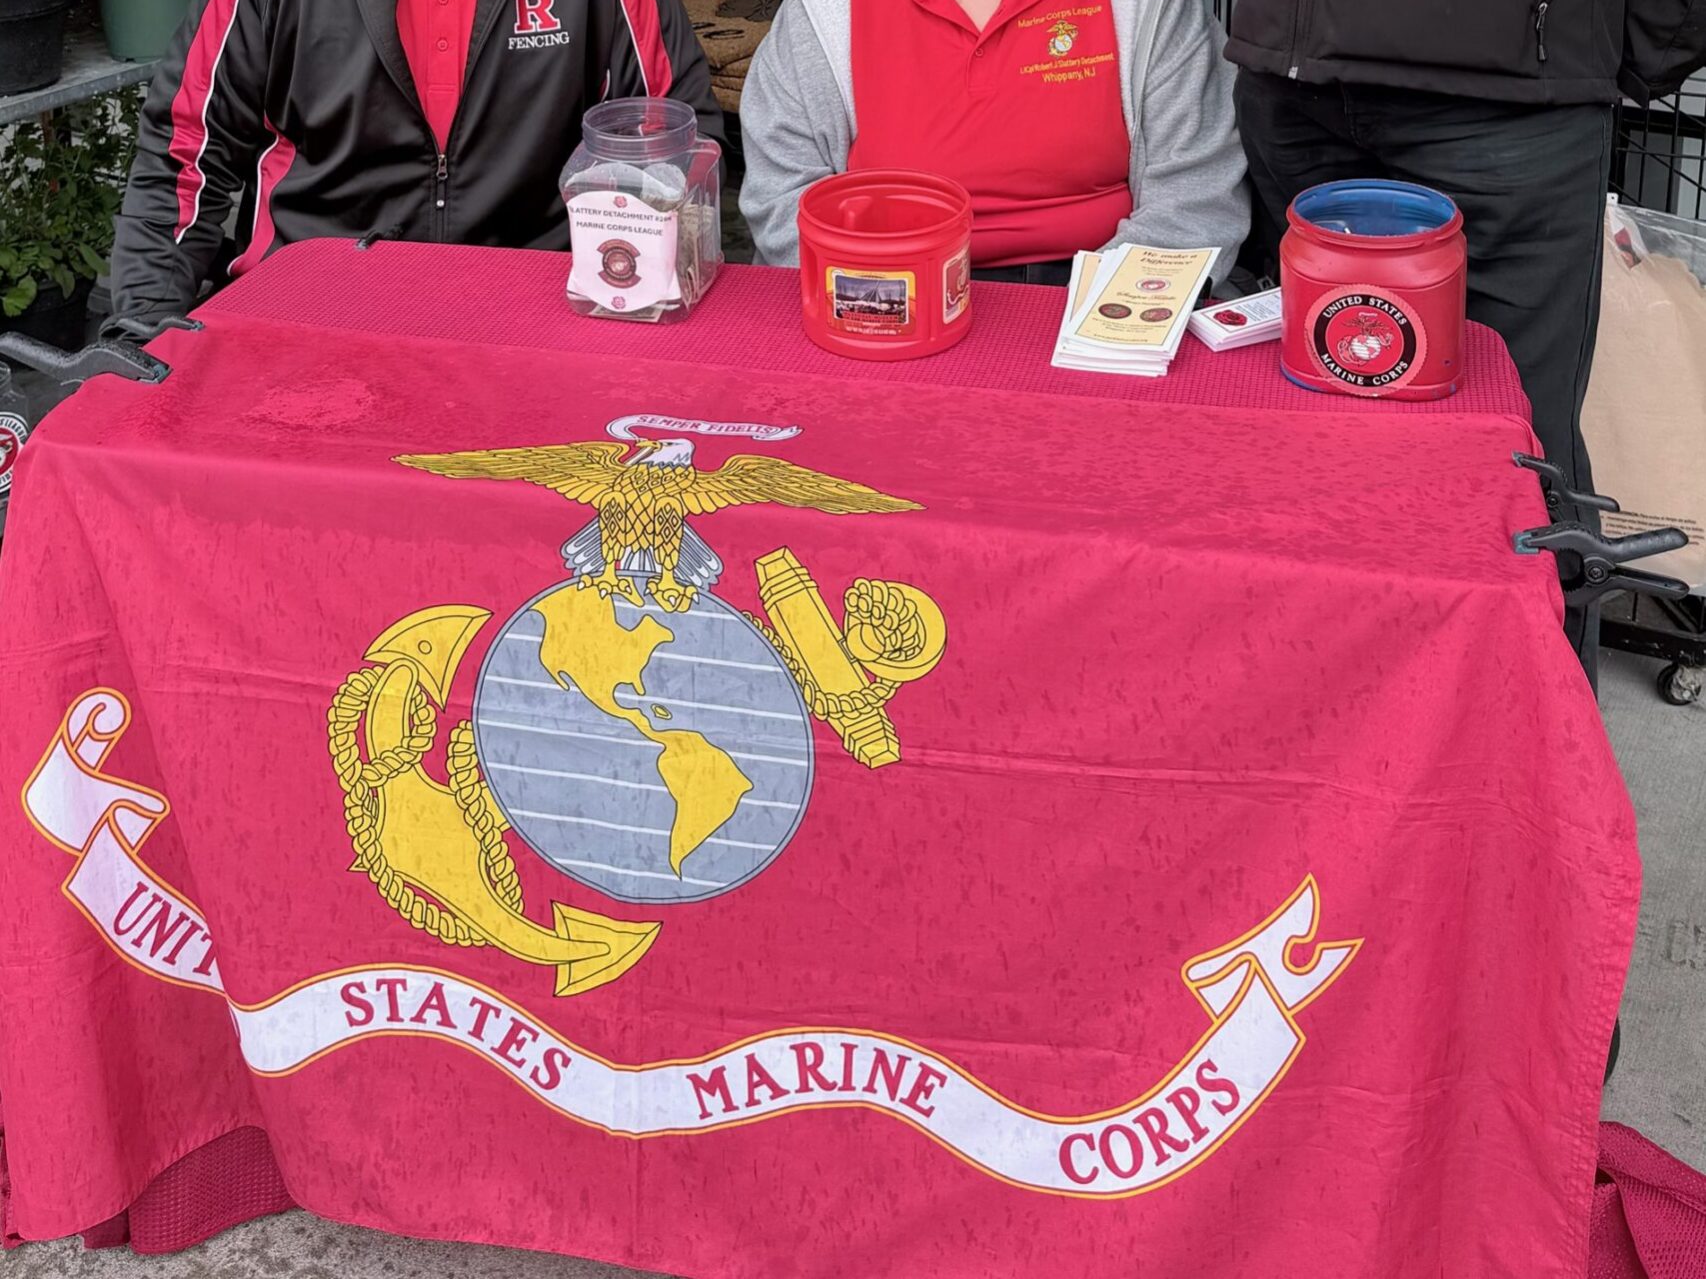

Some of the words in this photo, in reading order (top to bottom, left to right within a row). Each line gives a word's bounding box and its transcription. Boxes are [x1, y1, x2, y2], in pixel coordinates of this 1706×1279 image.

[1018, 16, 1046, 28] Marine
[1046, 9, 1072, 20] Corps
[1072, 5, 1102, 17] League
[508, 31, 570, 50] FENCING
[1083, 66, 1096, 78] NJ
[603, 209, 654, 221] DETACHMENT
[576, 221, 605, 230] MARINE
[607, 223, 633, 233] CORPS
[634, 226, 663, 236] LEAGUE
[1323, 295, 1363, 319] UNITED
[1368, 297, 1408, 326] STATES
[1320, 352, 1365, 386] MARINE
[1372, 359, 1409, 386] CORPS
[636, 415, 702, 431] SEMPER
[706, 423, 773, 435] FIDELIS
[113, 880, 217, 977] UNIT
[340, 977, 573, 1091] STATES
[686, 1040, 948, 1121] MARINE
[1057, 1058, 1241, 1186] CORPS
